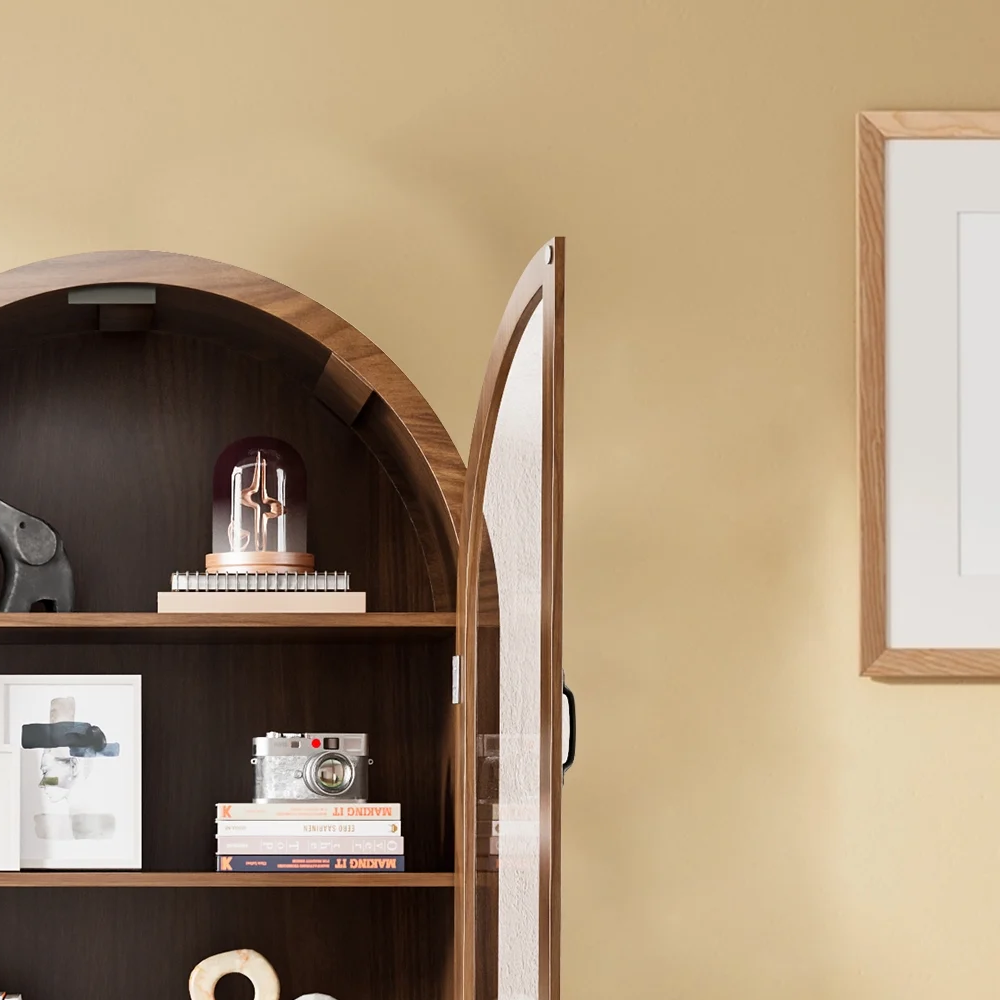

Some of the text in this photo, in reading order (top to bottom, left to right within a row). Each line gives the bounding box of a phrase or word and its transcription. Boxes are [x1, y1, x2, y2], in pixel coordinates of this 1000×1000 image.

[332, 806, 344, 816] IT
[348, 806, 392, 816] MAKING
[334, 858, 348, 869] IT
[350, 858, 397, 869] MAKING
